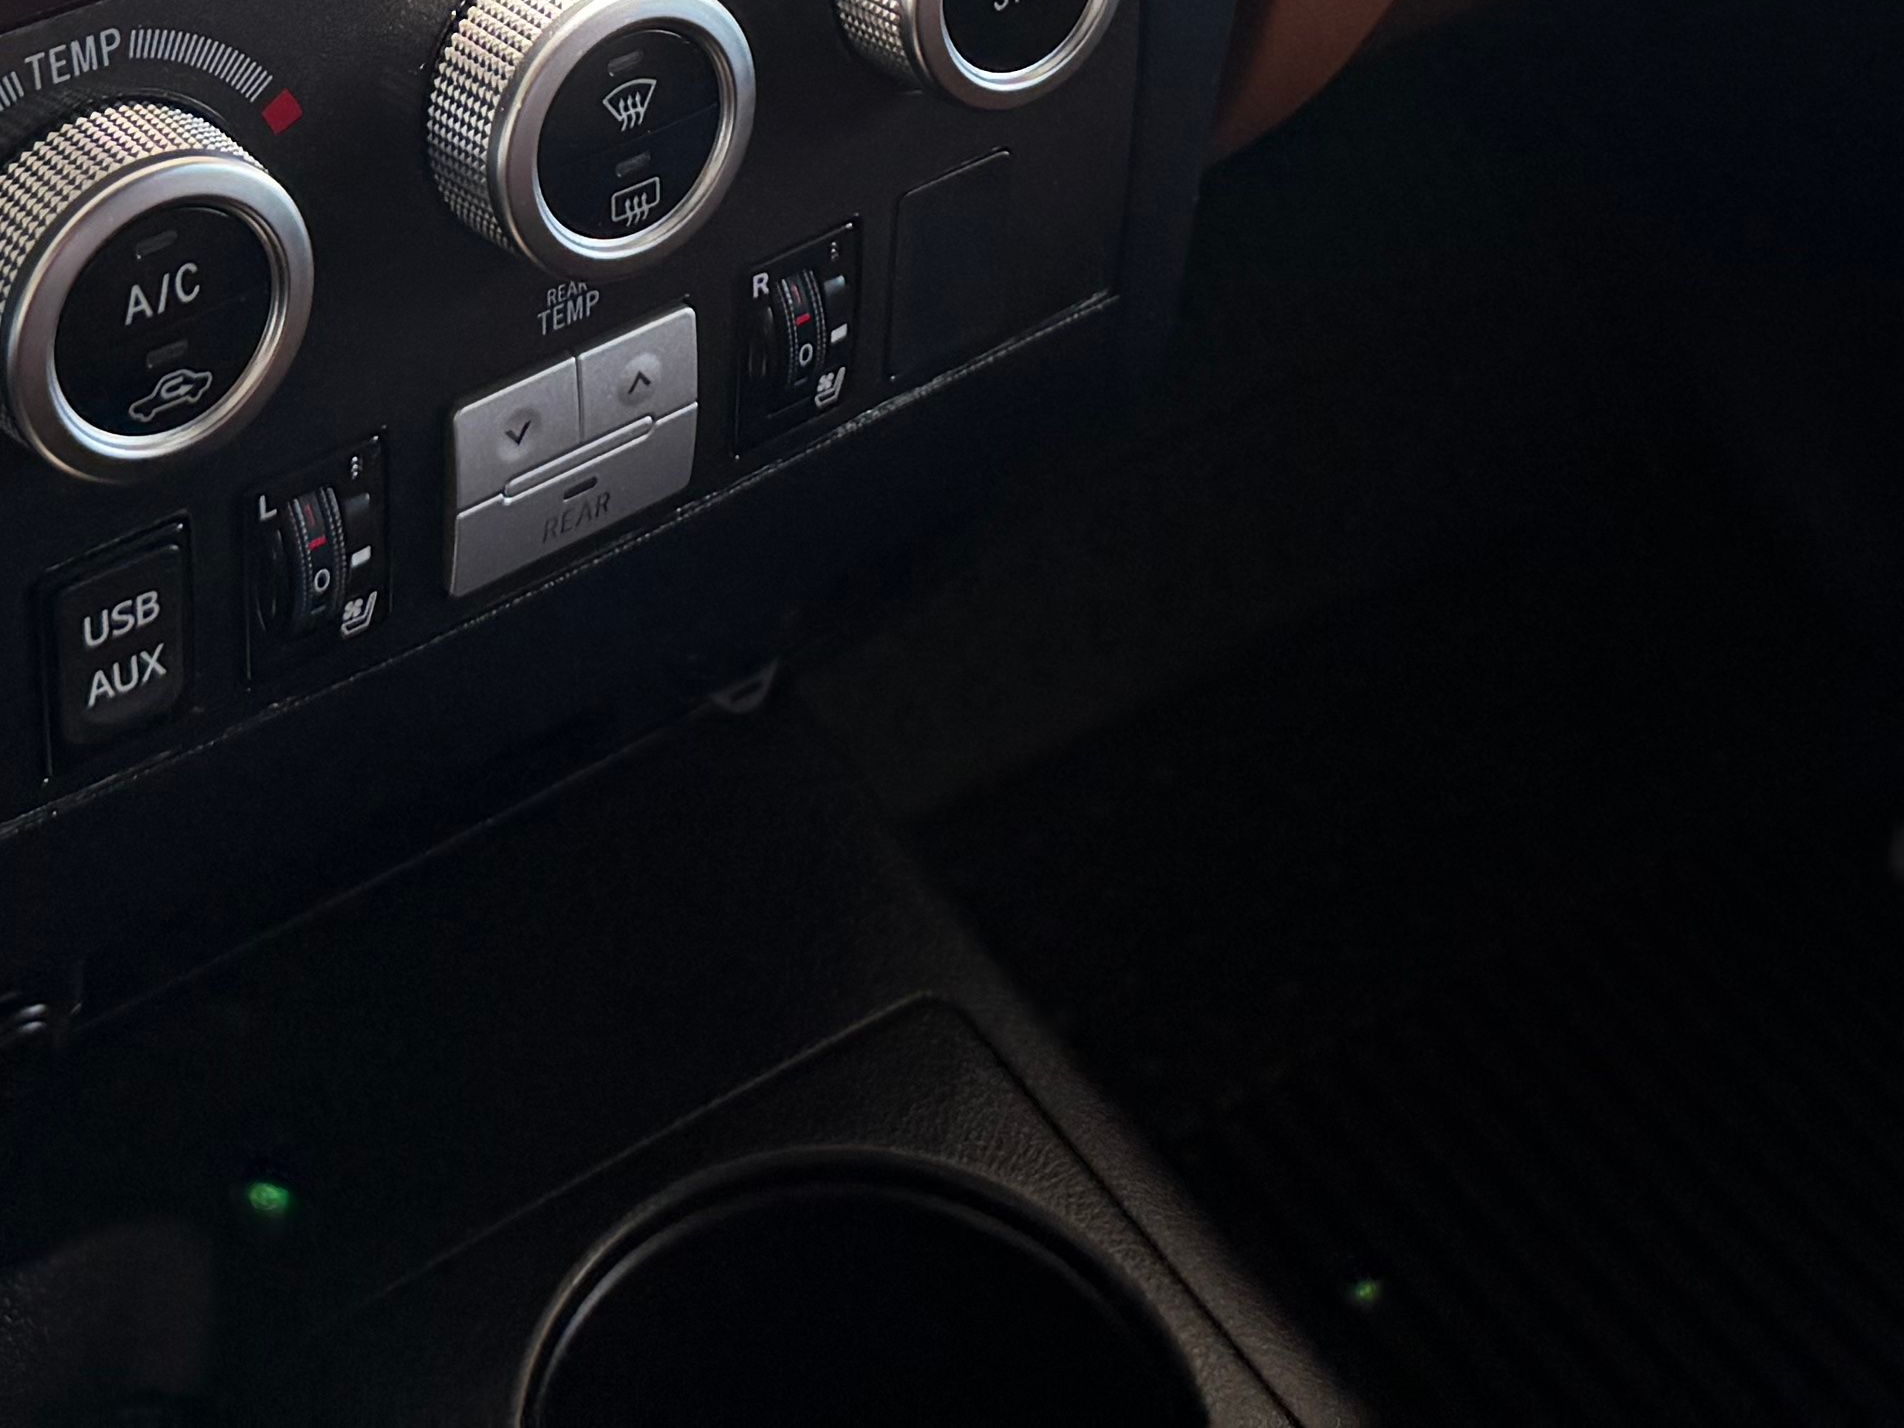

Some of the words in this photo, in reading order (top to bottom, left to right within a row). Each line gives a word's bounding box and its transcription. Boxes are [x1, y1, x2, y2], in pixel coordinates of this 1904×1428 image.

[24, 27, 122, 92] TEMP
[125, 262, 201, 326] A/C
[537, 289, 600, 336] TEMP
[752, 271, 770, 299] R
[257, 493, 277, 521] L
[542, 490, 611, 544] REAR
[82, 590, 161, 648] USB
[86, 642, 168, 709] AUX
